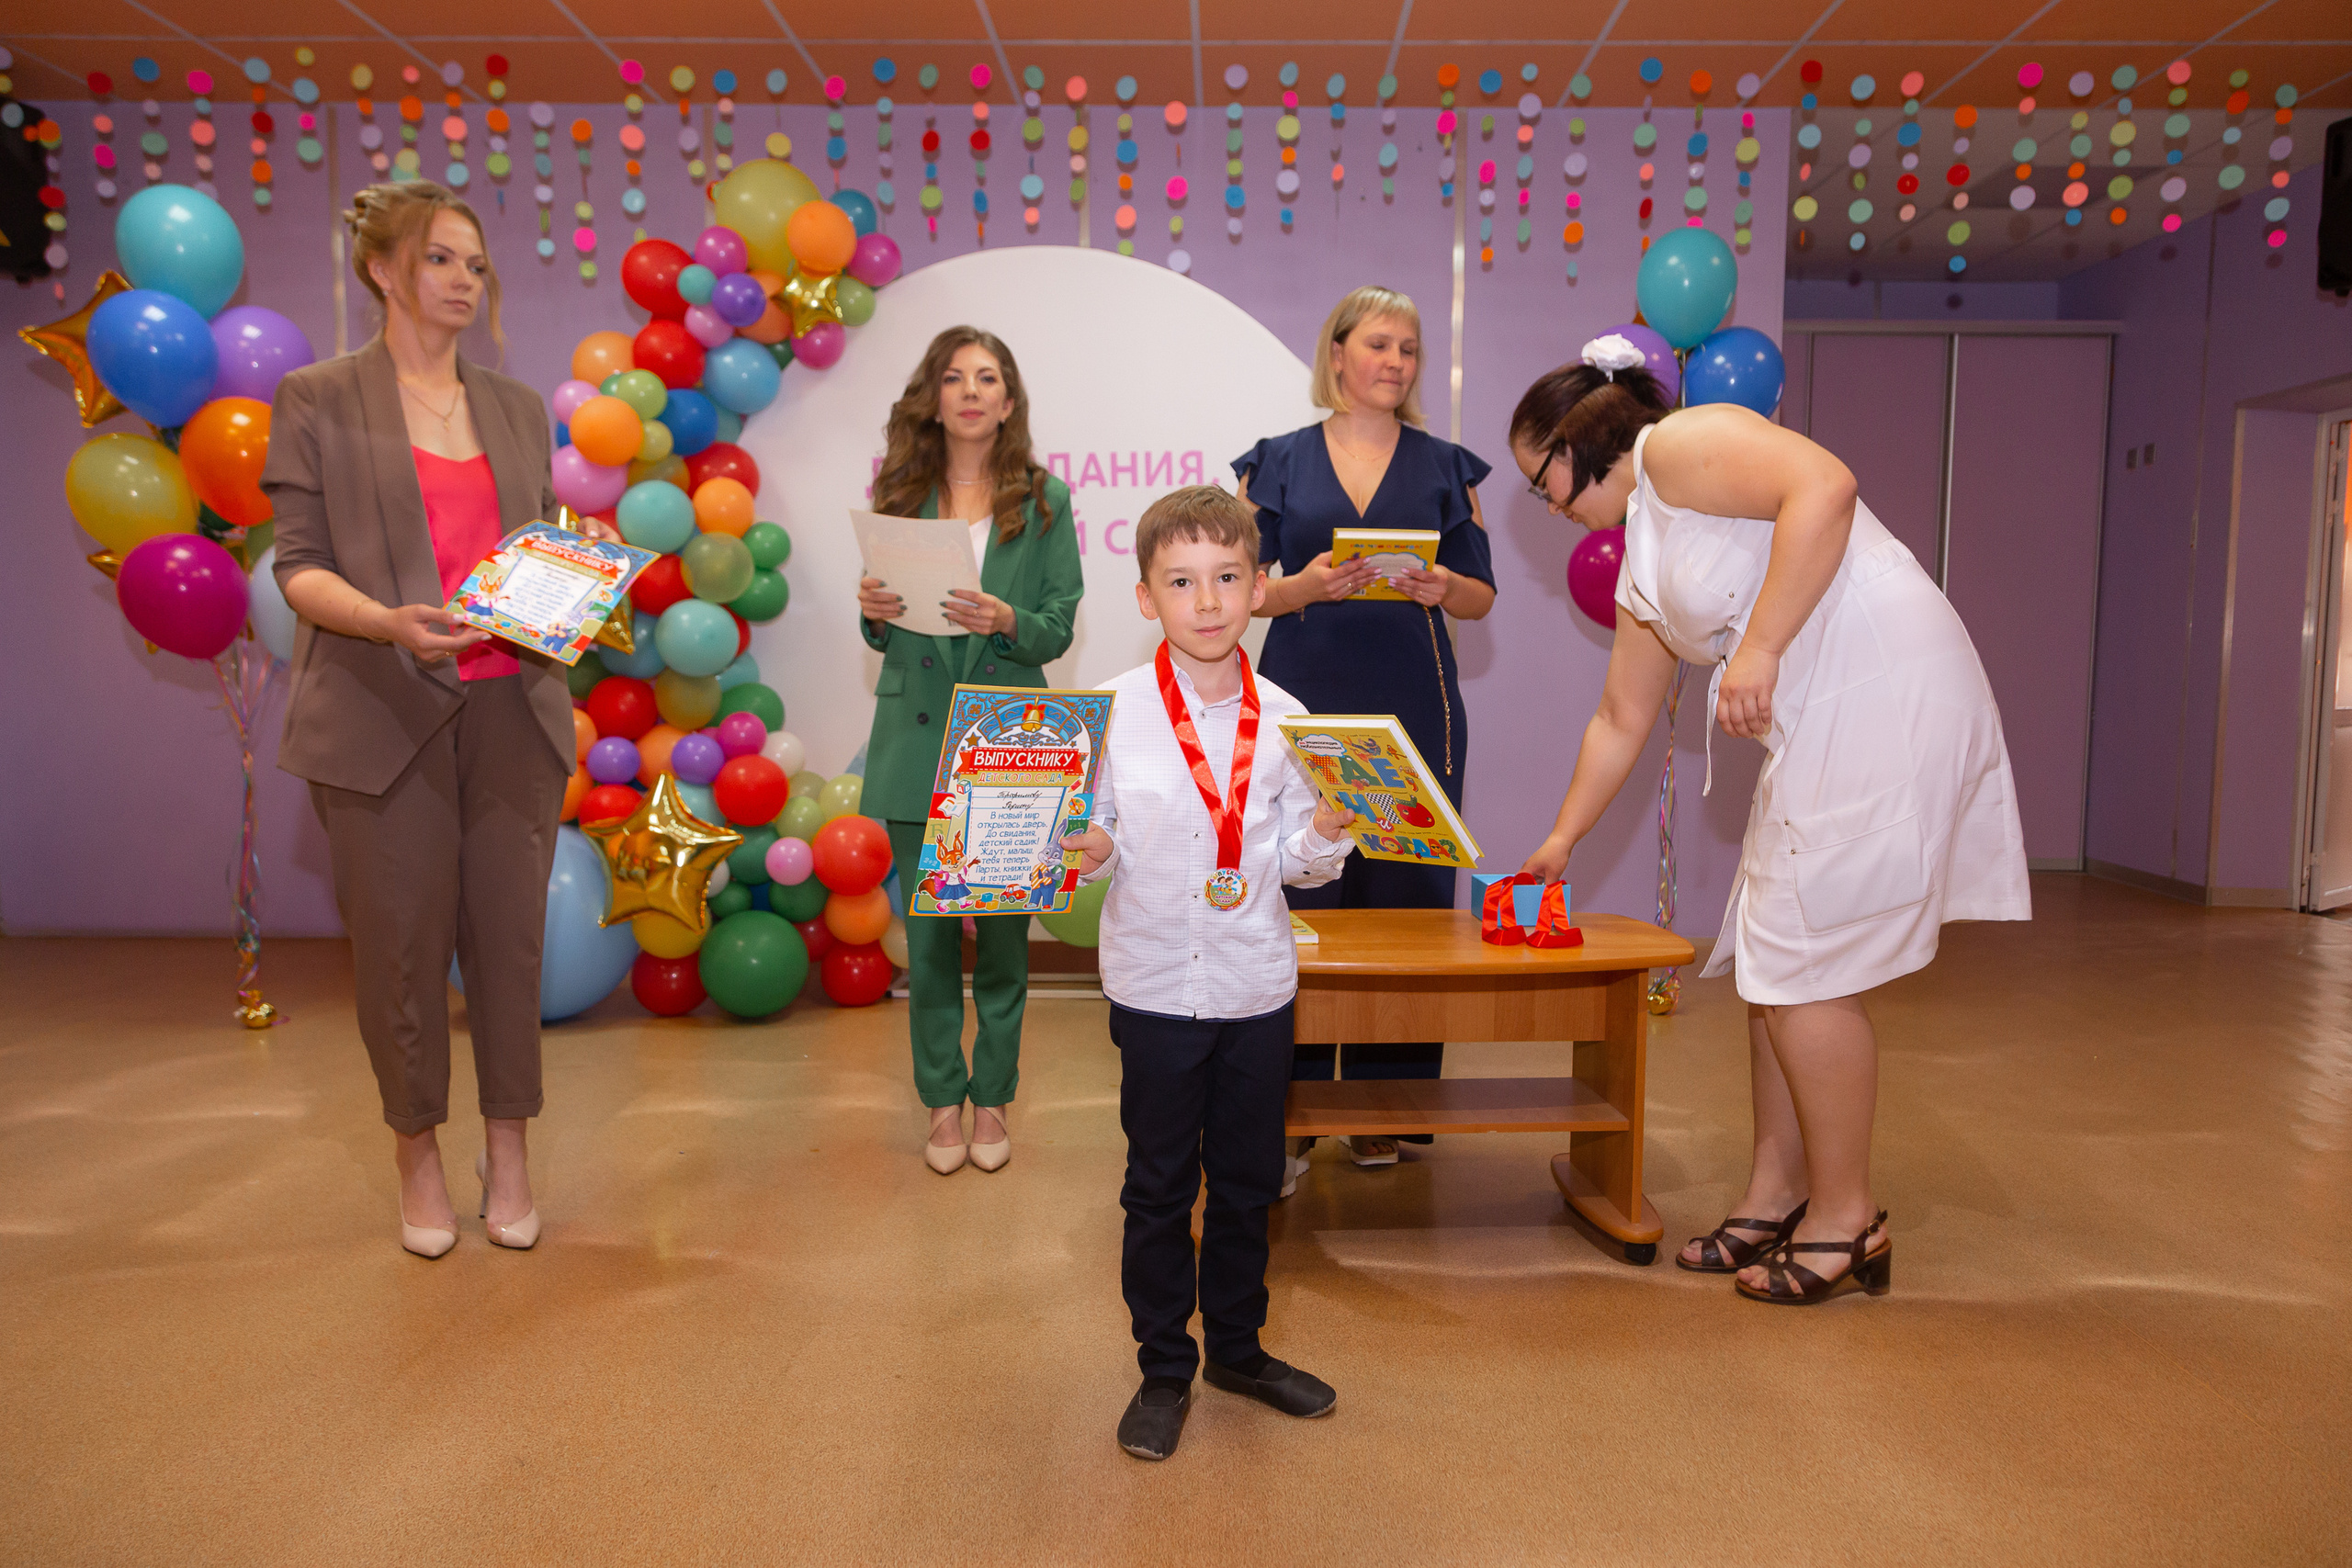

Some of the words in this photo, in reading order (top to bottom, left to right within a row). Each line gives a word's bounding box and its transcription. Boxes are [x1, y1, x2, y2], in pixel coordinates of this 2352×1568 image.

[1030, 450, 1220, 494] ДАНИЯ,
[531, 539, 614, 572] ВЫПУСКНИКУ
[974, 750, 1074, 767] ВЫПУСКНИКУ
[978, 773, 1032, 784] ДЕТСКОГО
[1035, 773, 1062, 783] САДА
[990, 811, 996, 819] В
[998, 811, 1023, 819] новый
[1024, 812, 1040, 821] мир
[977, 821, 1020, 830] открылась
[985, 829, 997, 838] До
[978, 838, 1012, 847] детский
[1013, 837, 1039, 846] садик!
[981, 856, 1001, 864] тебя
[1002, 856, 1030, 864] теперь
[989, 873, 1023, 883] тетради!
